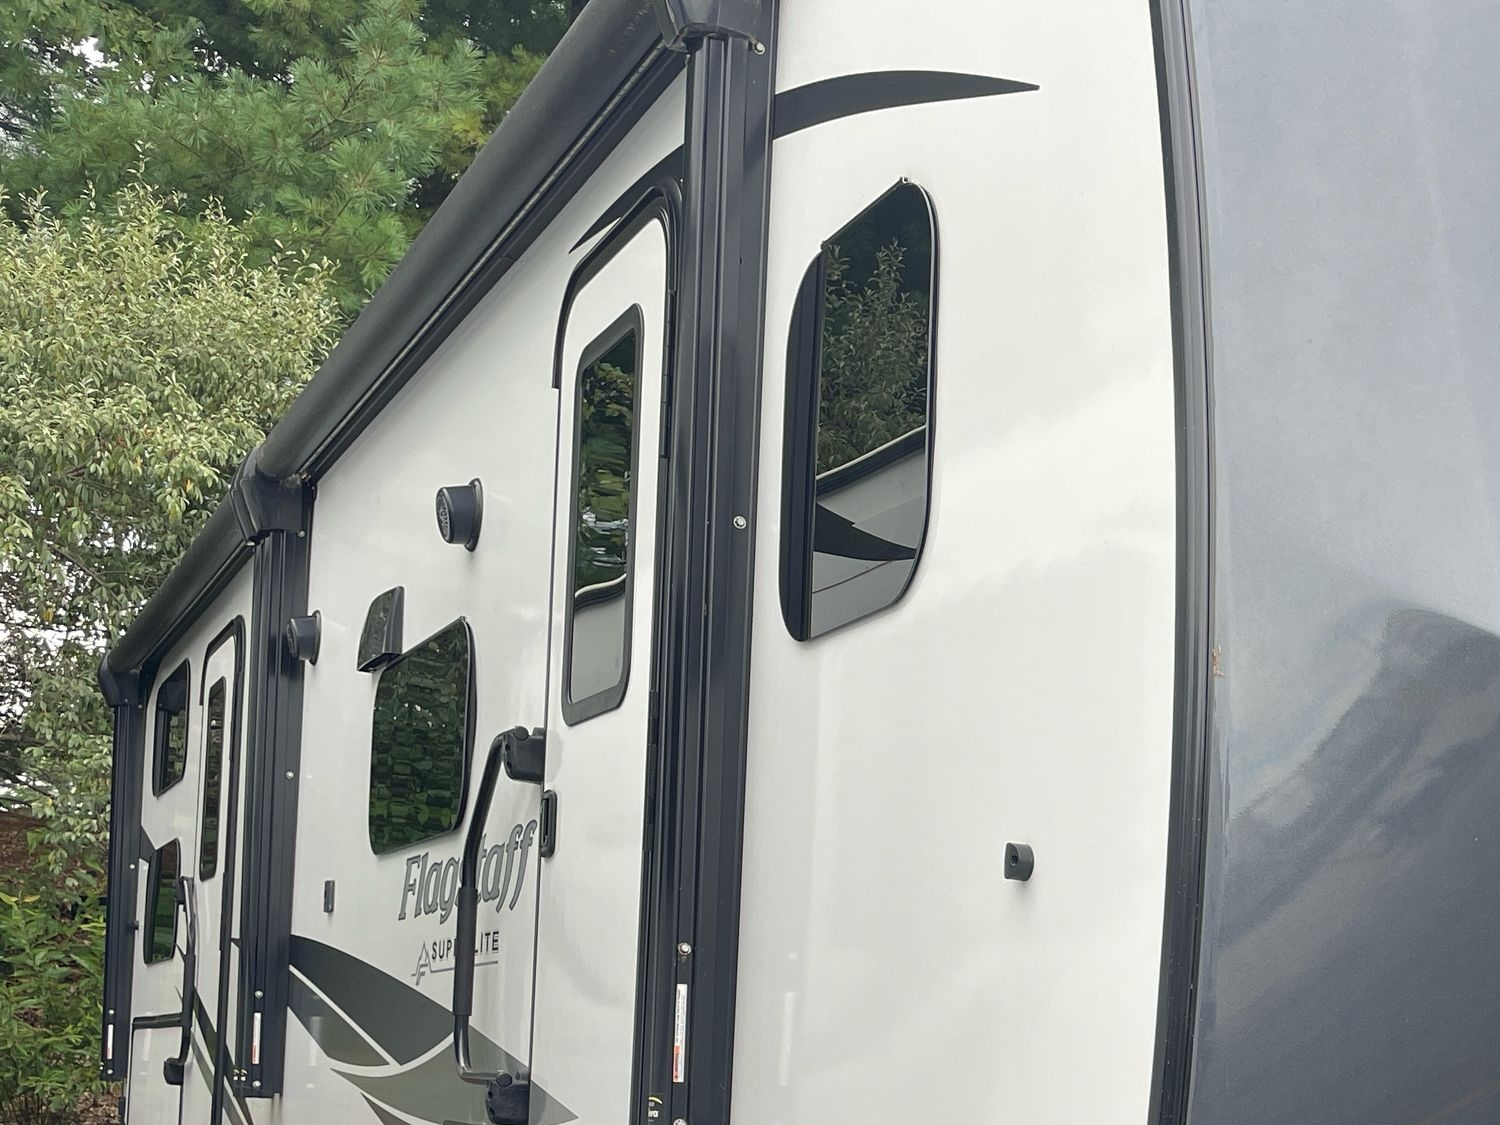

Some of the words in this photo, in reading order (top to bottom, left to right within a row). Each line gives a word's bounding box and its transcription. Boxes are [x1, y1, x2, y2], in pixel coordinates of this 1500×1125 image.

[398, 819, 538, 925] Flagaff
[431, 937, 458, 960] SUP
[474, 931, 500, 954] ITE
